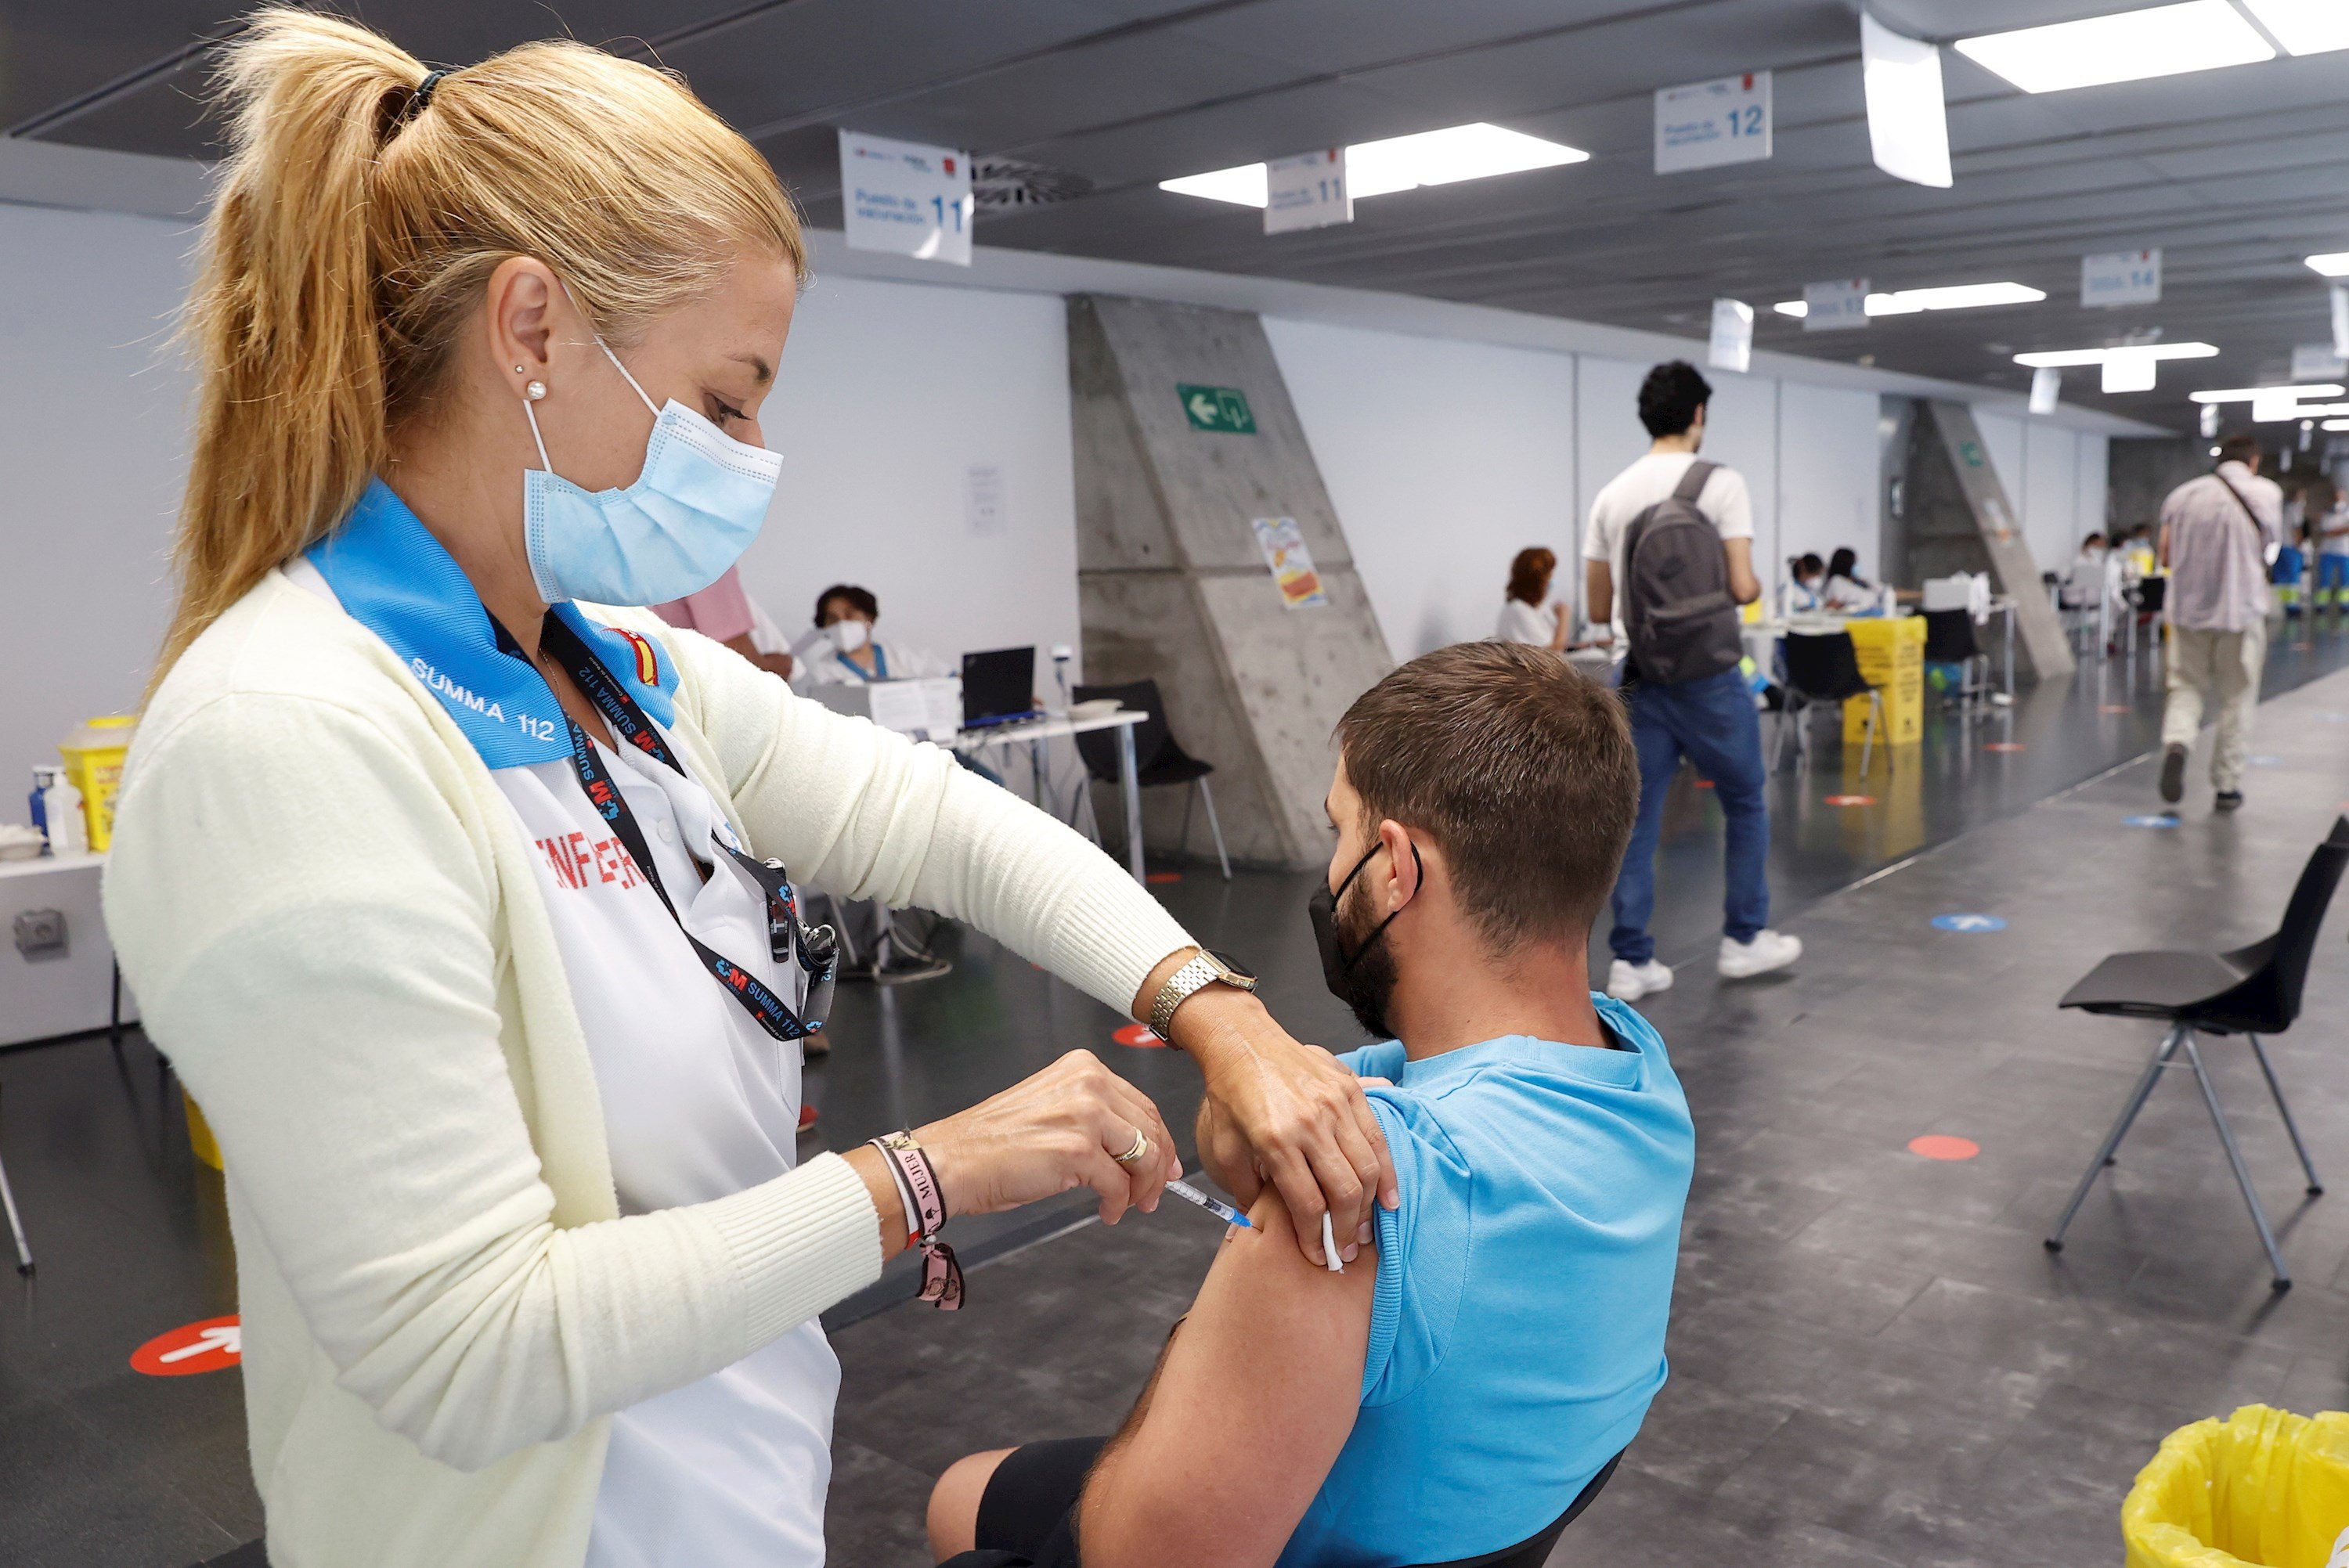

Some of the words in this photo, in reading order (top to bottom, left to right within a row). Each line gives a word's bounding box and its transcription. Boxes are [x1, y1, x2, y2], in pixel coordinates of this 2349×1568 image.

[1728, 105, 1763, 136] 12
[1319, 178, 1341, 201] 11
[931, 195, 962, 233] 11
[413, 658, 505, 723] SUMMA
[518, 714, 555, 741] 112
[578, 666, 599, 689] 112
[597, 687, 636, 734] SUMMA
[573, 723, 595, 780] SUMMA
[747, 982, 784, 1022] SUMMA
[781, 1018, 801, 1037] 112
[904, 1153, 933, 1200] MUJER
